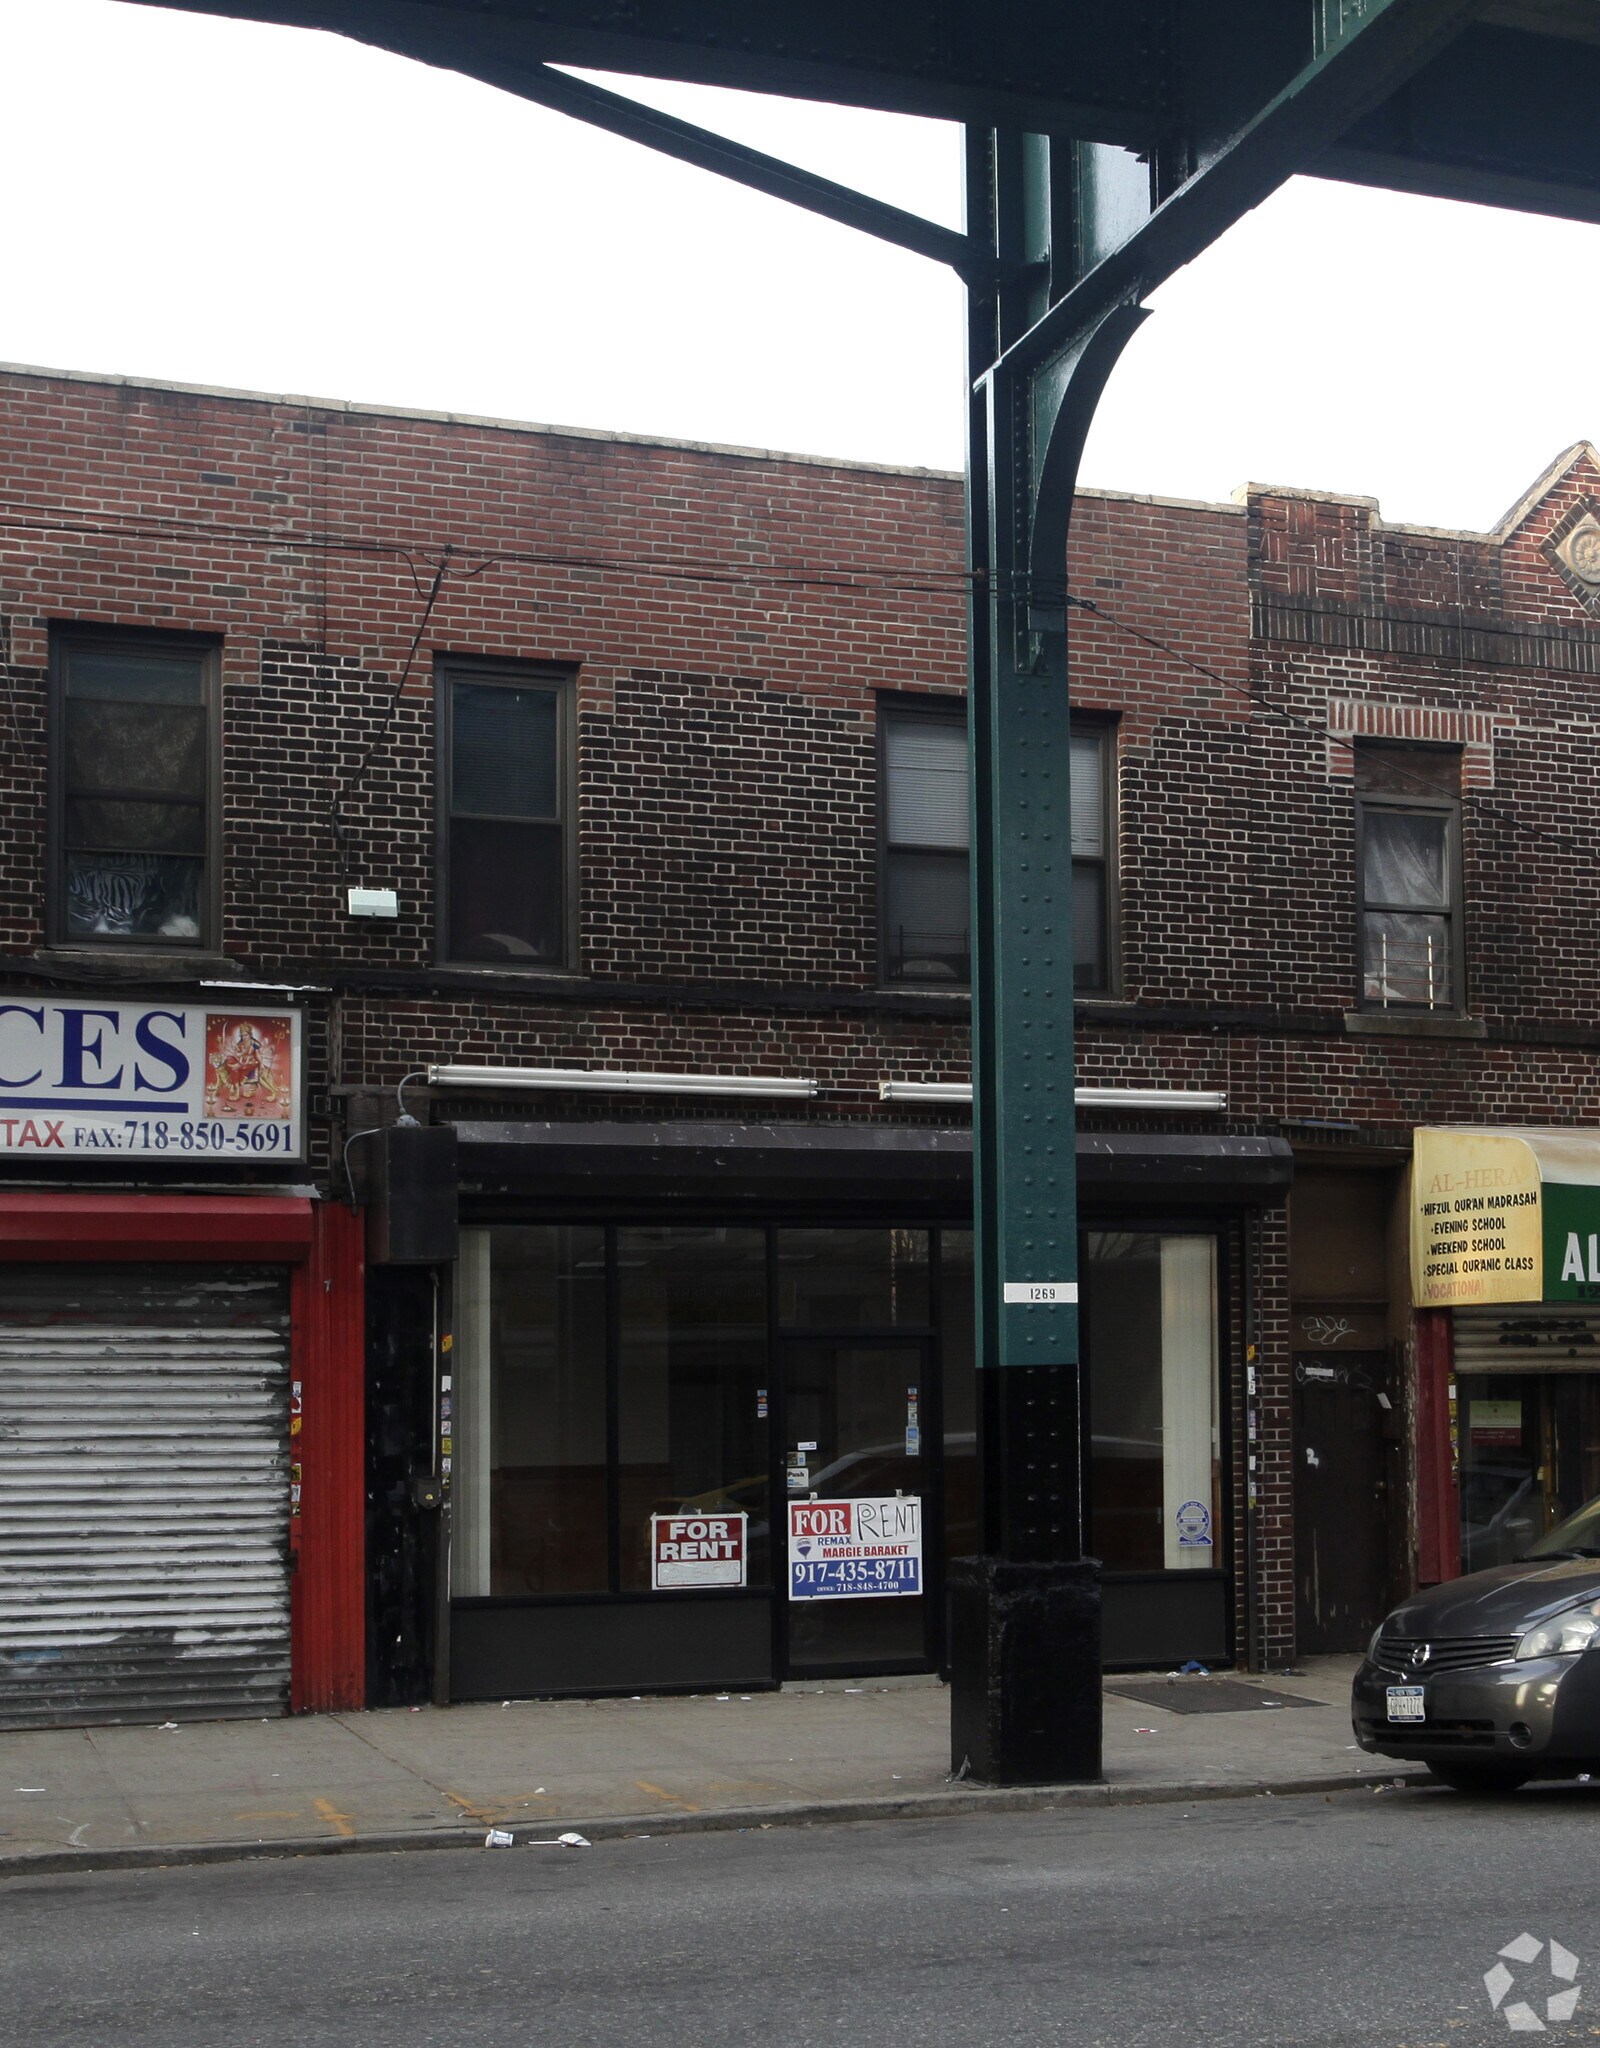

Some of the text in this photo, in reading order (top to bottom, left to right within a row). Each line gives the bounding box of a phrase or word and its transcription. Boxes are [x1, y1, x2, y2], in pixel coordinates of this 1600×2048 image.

[0, 1119, 65, 1148] TAX
[124, 1120, 293, 1151] 718-850-5691
[1424, 1201, 1451, 1216] HIFZUL
[1487, 1191, 1537, 1209] MADRASAH
[1434, 1217, 1506, 1235] EVENING SCHOOL
[1430, 1238, 1506, 1256] WEEKEND SCHOOL
[1426, 1261, 1459, 1277] SPECIAL
[1504, 1257, 1533, 1271] CLASS
[1030, 1288, 1056, 1300] 1269
[669, 1521, 728, 1540] FOR
[794, 1503, 918, 1541] FOR RENT
[660, 1541, 738, 1560] RENT
[818, 1536, 852, 1546] REMAX
[822, 1545, 909, 1558] MARGIE BARAKET
[795, 1559, 917, 1584] 917-435-8711
[836, 1581, 899, 1592] 718-848-4700
